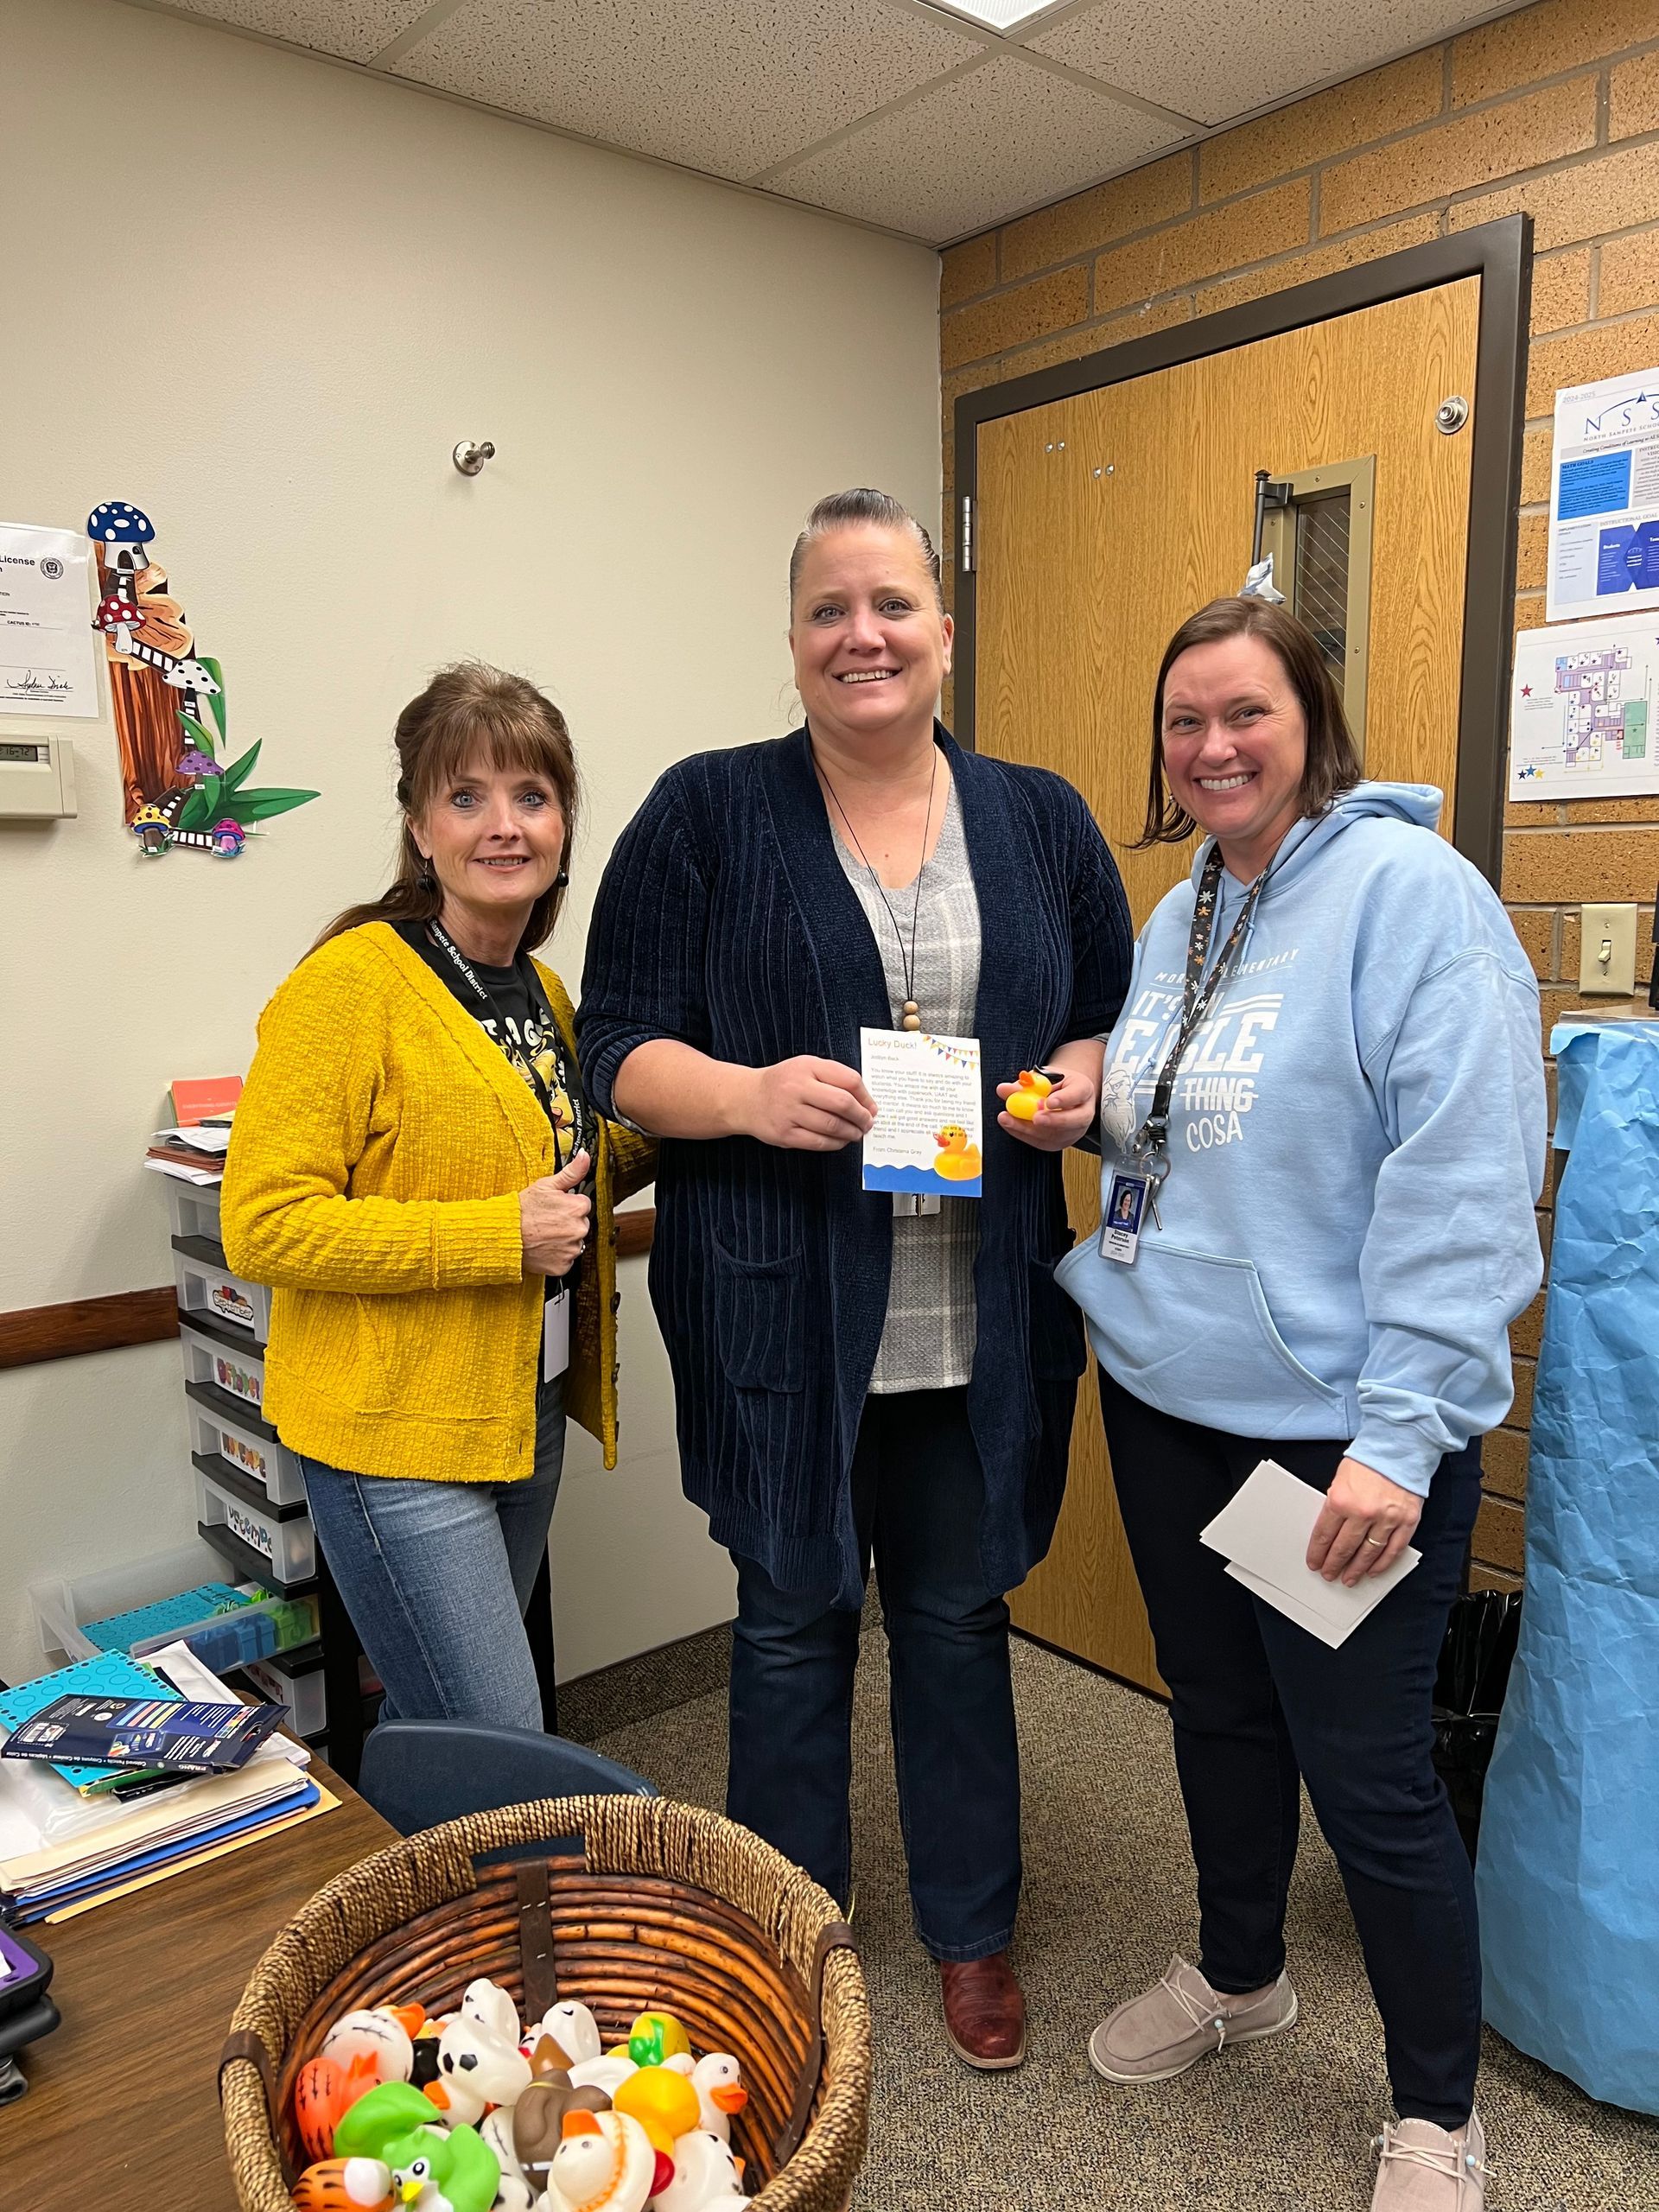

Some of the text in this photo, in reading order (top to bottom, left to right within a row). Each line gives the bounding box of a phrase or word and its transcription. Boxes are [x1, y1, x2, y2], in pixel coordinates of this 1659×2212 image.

[1563, 391, 1596, 404] 2024-2025
[1599, 516, 1642, 526] INSTRUCTIONAL
[430, 918, 488, 1000] Sanpete School District
[868, 1038, 916, 1050] Lucky Duck!
[1180, 1077, 1258, 1114] THING
[1186, 1111, 1243, 1152] COSA
[214, 1293, 252, 1319] September
